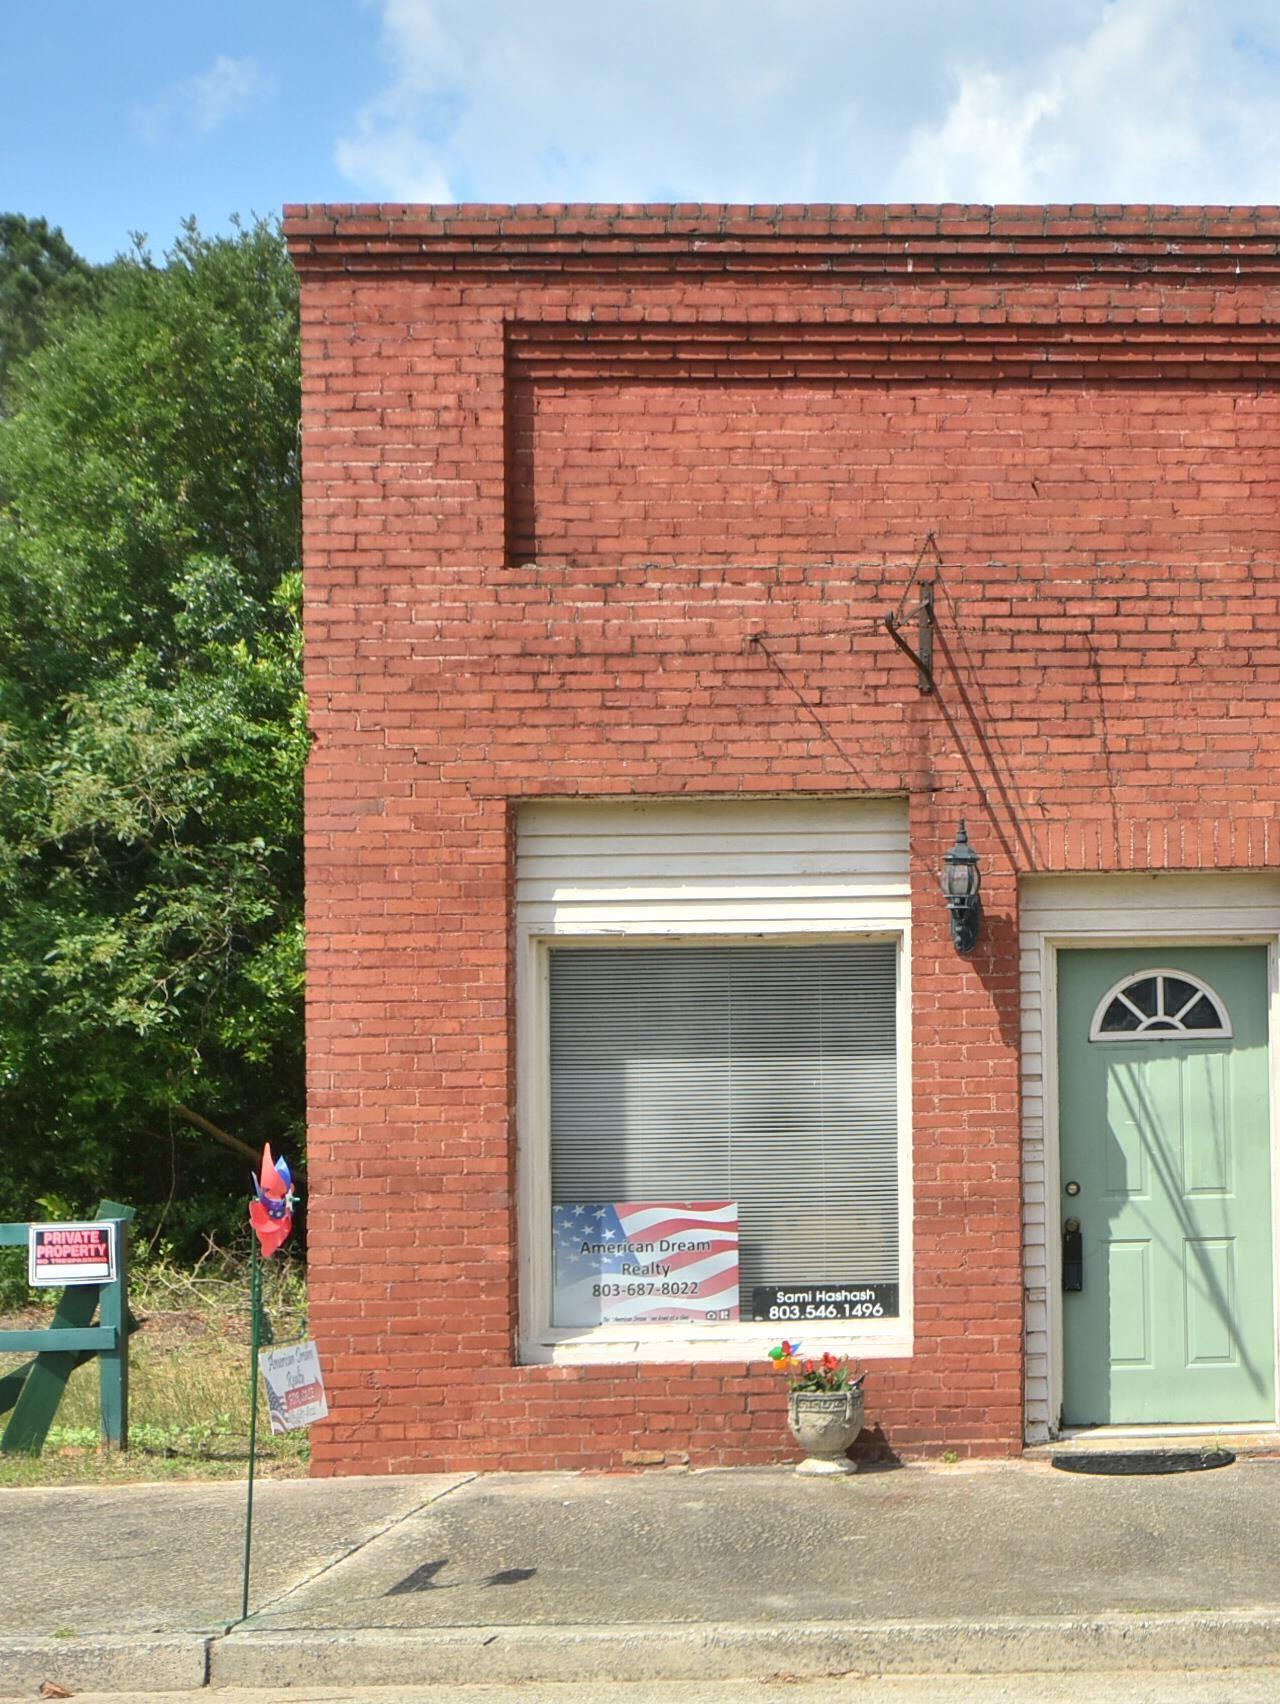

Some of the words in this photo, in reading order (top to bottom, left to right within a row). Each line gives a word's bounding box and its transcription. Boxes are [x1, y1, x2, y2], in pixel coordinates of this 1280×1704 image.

[43, 1231, 99, 1245] PRIVATE
[37, 1243, 107, 1258] PROPERTY
[580, 1241, 654, 1254] American
[659, 1239, 711, 1253] Dream
[622, 1262, 671, 1277] Realty
[592, 1282, 699, 1297] 803-687-8022
[776, 1291, 812, 1303] Sami
[815, 1289, 875, 1302] Hashash
[769, 1303, 883, 1319] 803.546.1496
